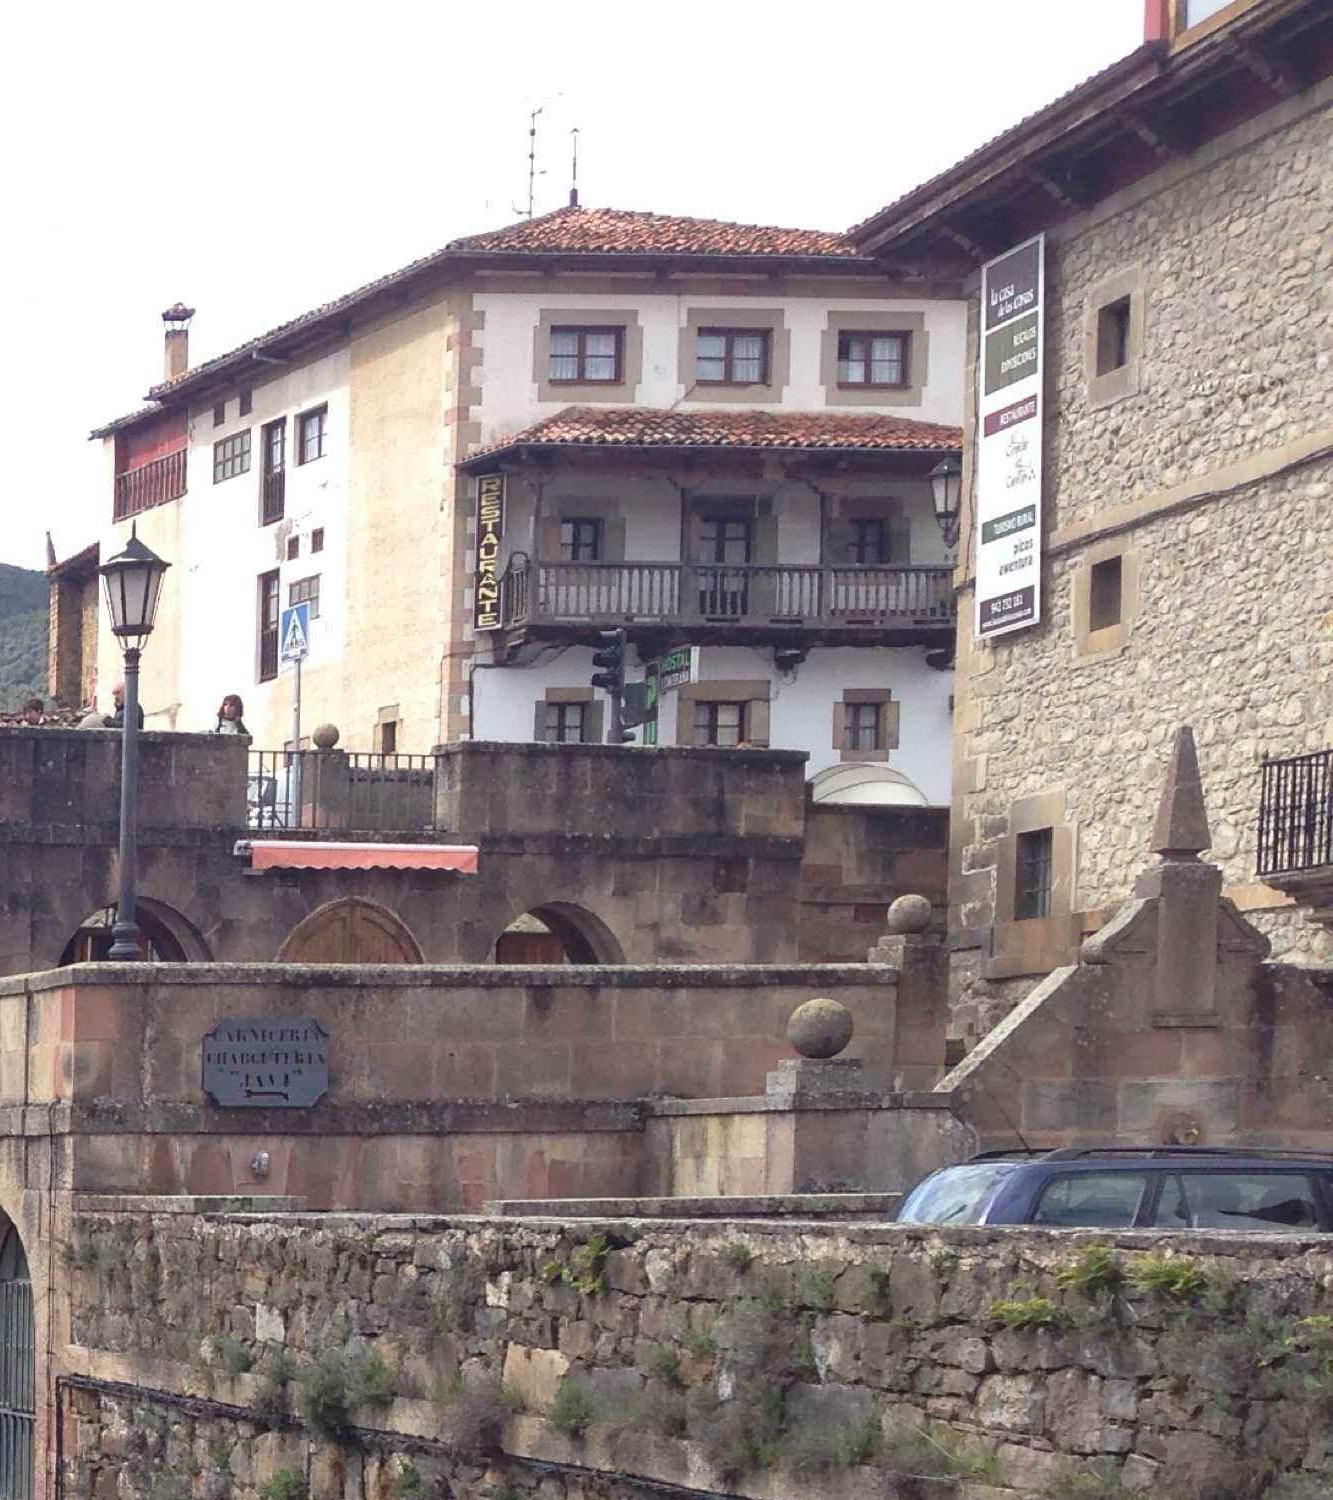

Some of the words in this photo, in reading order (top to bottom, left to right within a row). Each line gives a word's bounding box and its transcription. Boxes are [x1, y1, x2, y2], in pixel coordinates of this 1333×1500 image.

[999, 284, 1014, 302] casa
[1000, 400, 1036, 426] RESTAURANTE
[994, 516, 1016, 535] TURISMO
[1016, 511, 1034, 527] RURAL
[477, 478, 501, 627] RESTAURANTE
[1013, 538, 1033, 559] picos
[661, 650, 691, 673] HOSTAL
